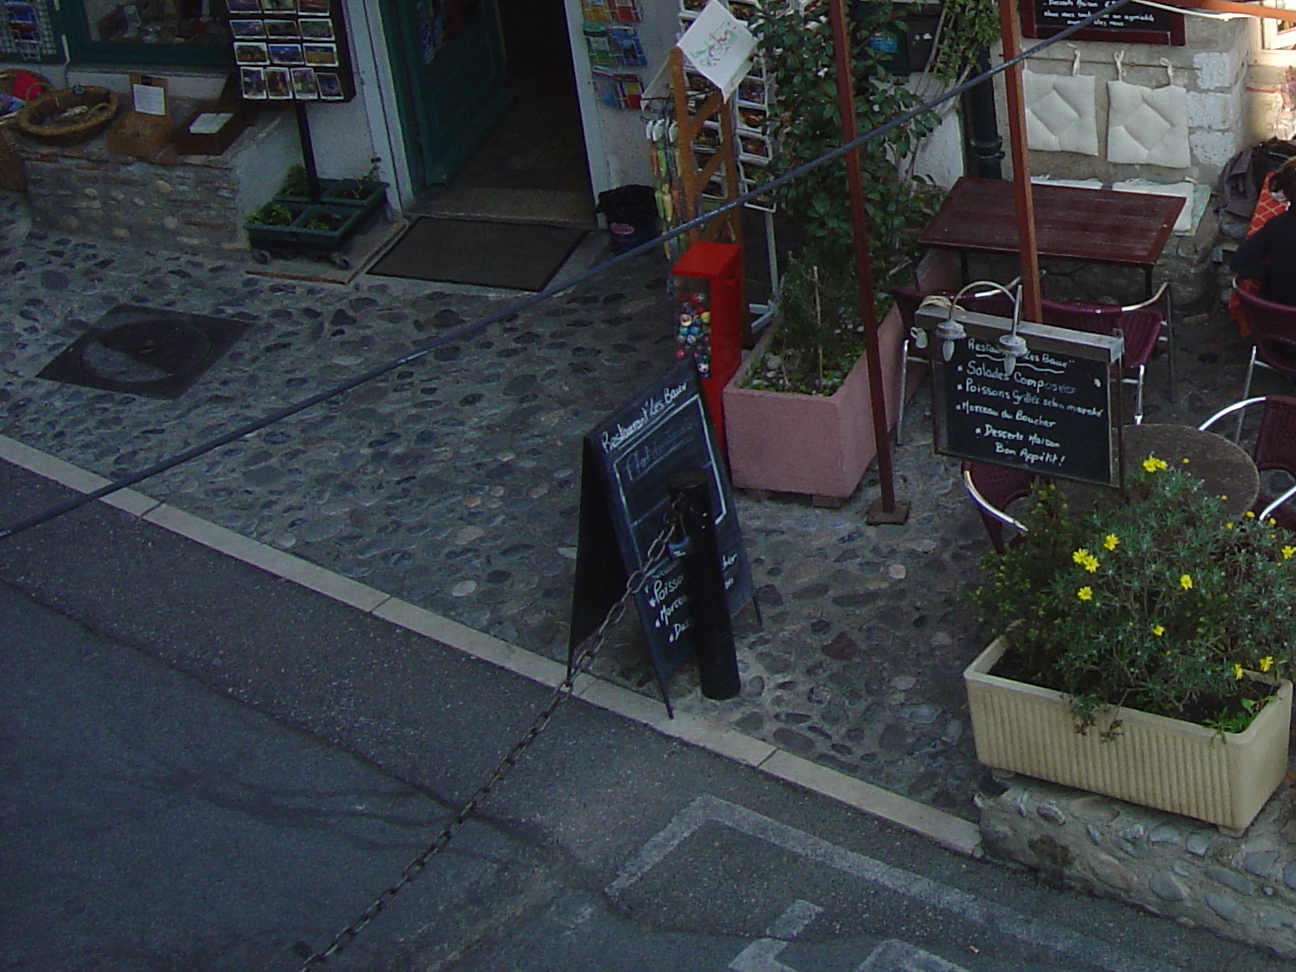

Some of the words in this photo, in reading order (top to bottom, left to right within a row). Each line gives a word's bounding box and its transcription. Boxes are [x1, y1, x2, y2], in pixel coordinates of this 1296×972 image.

[968, 337, 1001, 355] Restau
[967, 360, 1009, 381] Salades
[965, 378, 1011, 399] Poissons
[1015, 412, 1057, 428] Boucher
[995, 441, 1016, 456] Bon
[653, 574, 684, 605] Poisso
